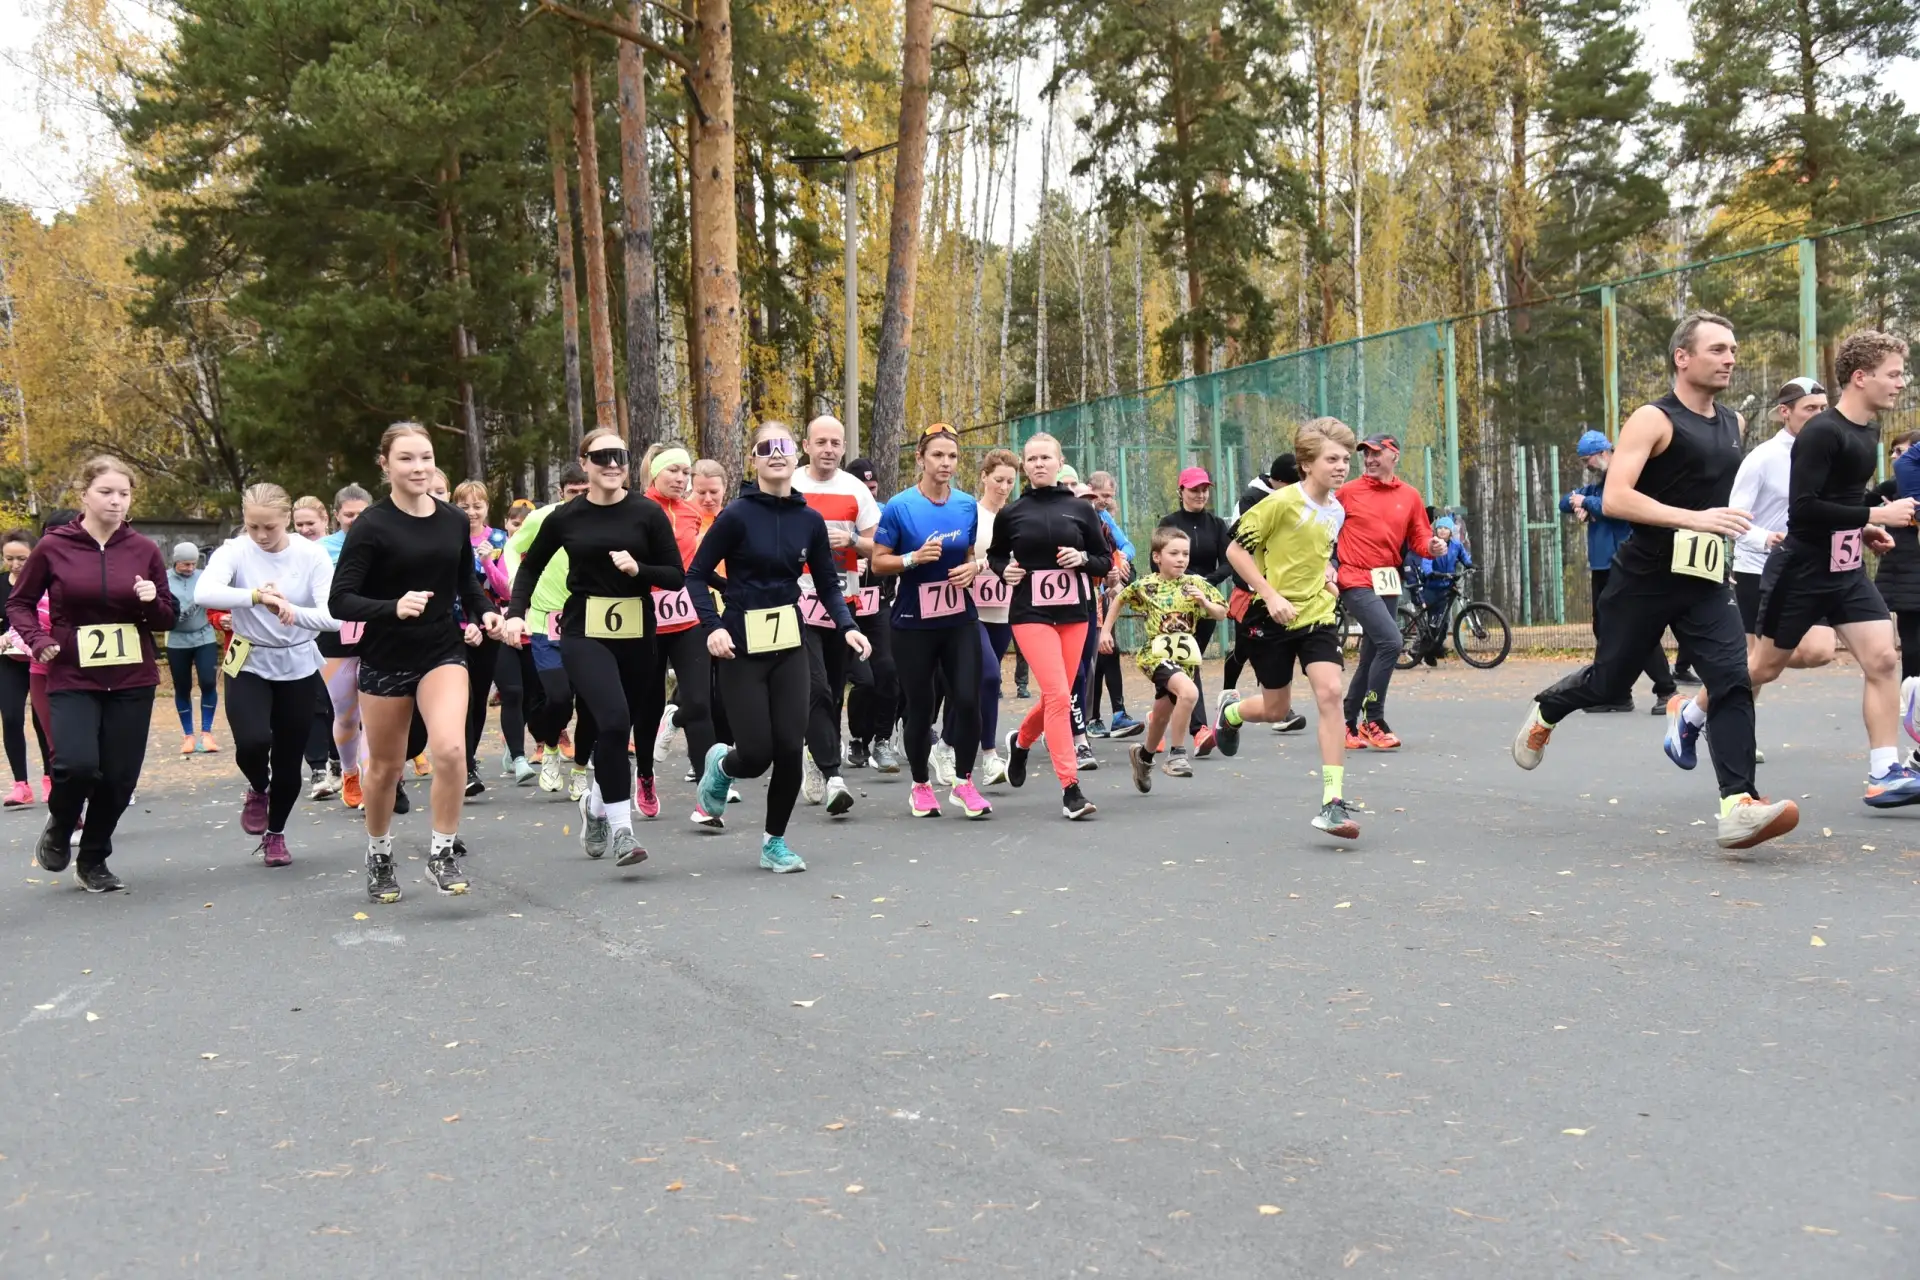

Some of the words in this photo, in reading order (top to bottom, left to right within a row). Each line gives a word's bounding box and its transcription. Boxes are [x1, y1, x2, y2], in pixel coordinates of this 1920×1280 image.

[1684, 536, 1718, 572] 10
[980, 579, 1007, 602] 60
[1040, 573, 1071, 600] 69
[1377, 570, 1397, 590] 30
[658, 591, 689, 620] 66
[928, 583, 958, 612] 70
[604, 601, 623, 632] 6
[765, 612, 780, 643] 7
[87, 628, 128, 659] 21
[1160, 636, 1191, 660] 35
